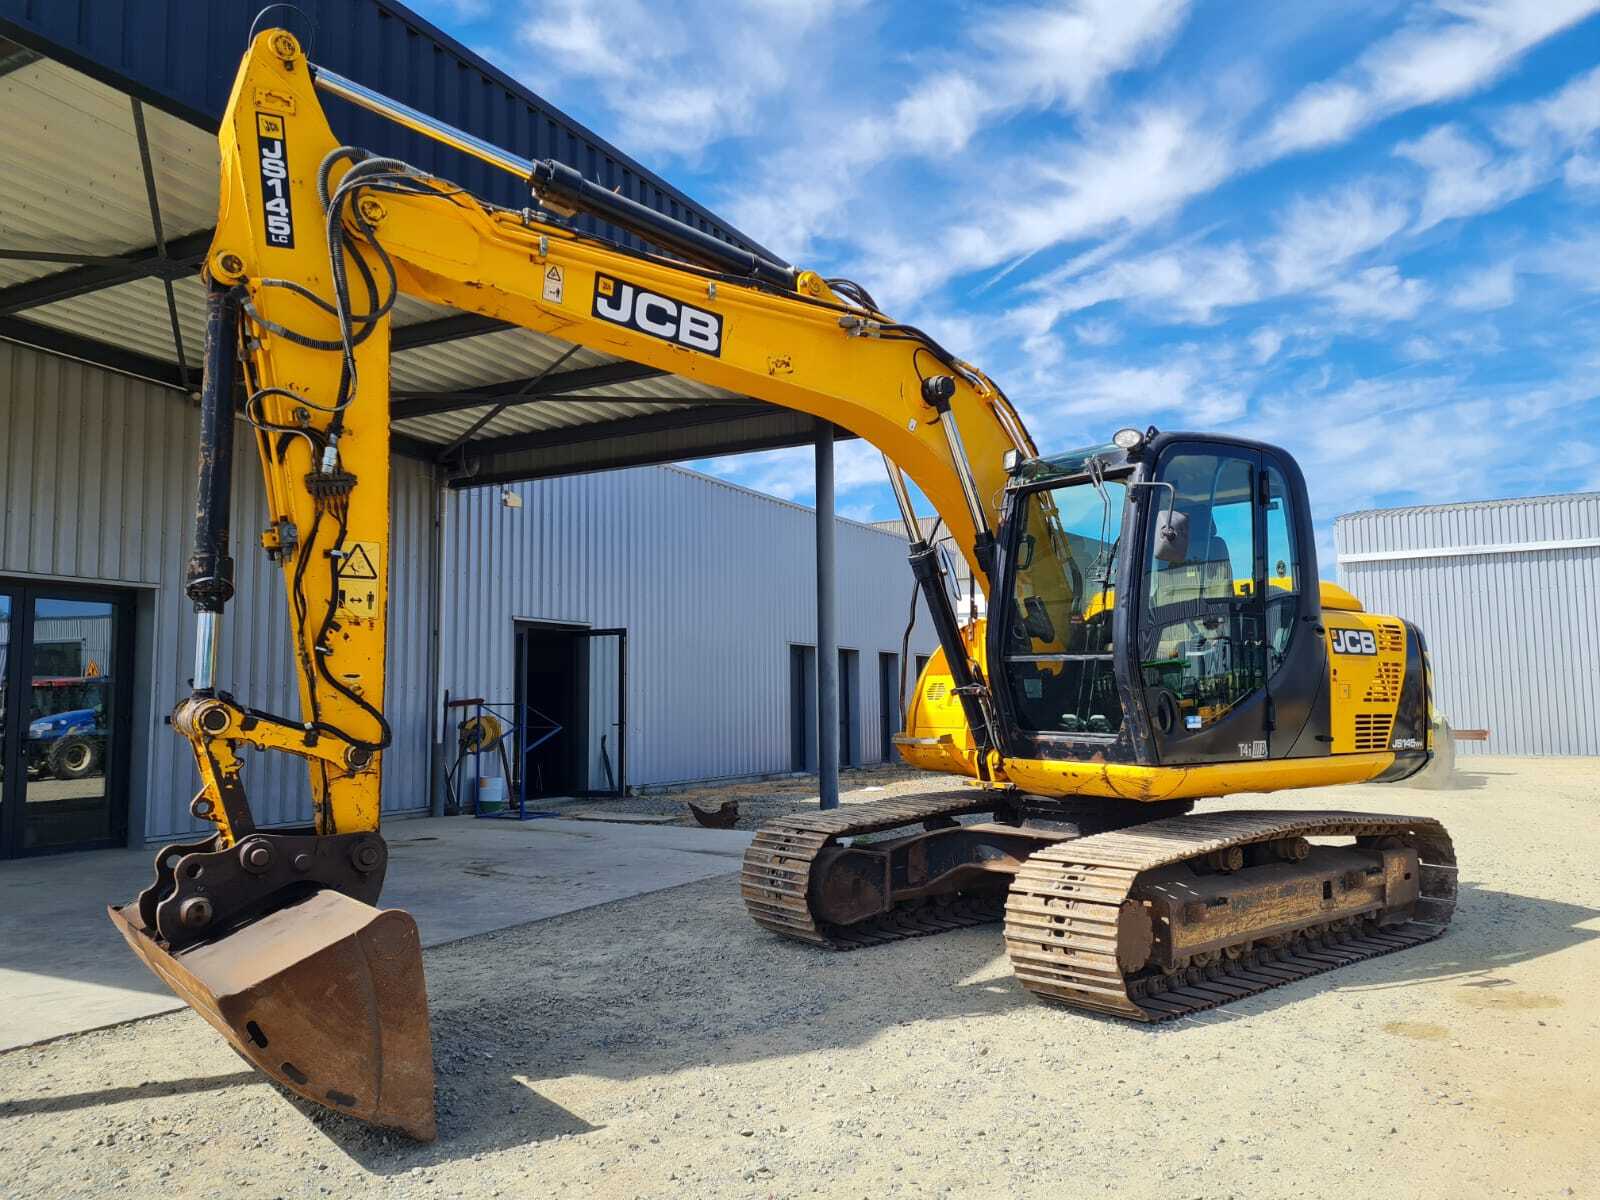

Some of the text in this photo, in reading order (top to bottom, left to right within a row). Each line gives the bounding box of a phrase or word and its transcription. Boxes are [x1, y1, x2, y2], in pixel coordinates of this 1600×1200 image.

[262, 140, 291, 235] JS145
[596, 284, 720, 352] JCB
[1332, 630, 1376, 653] JCB
